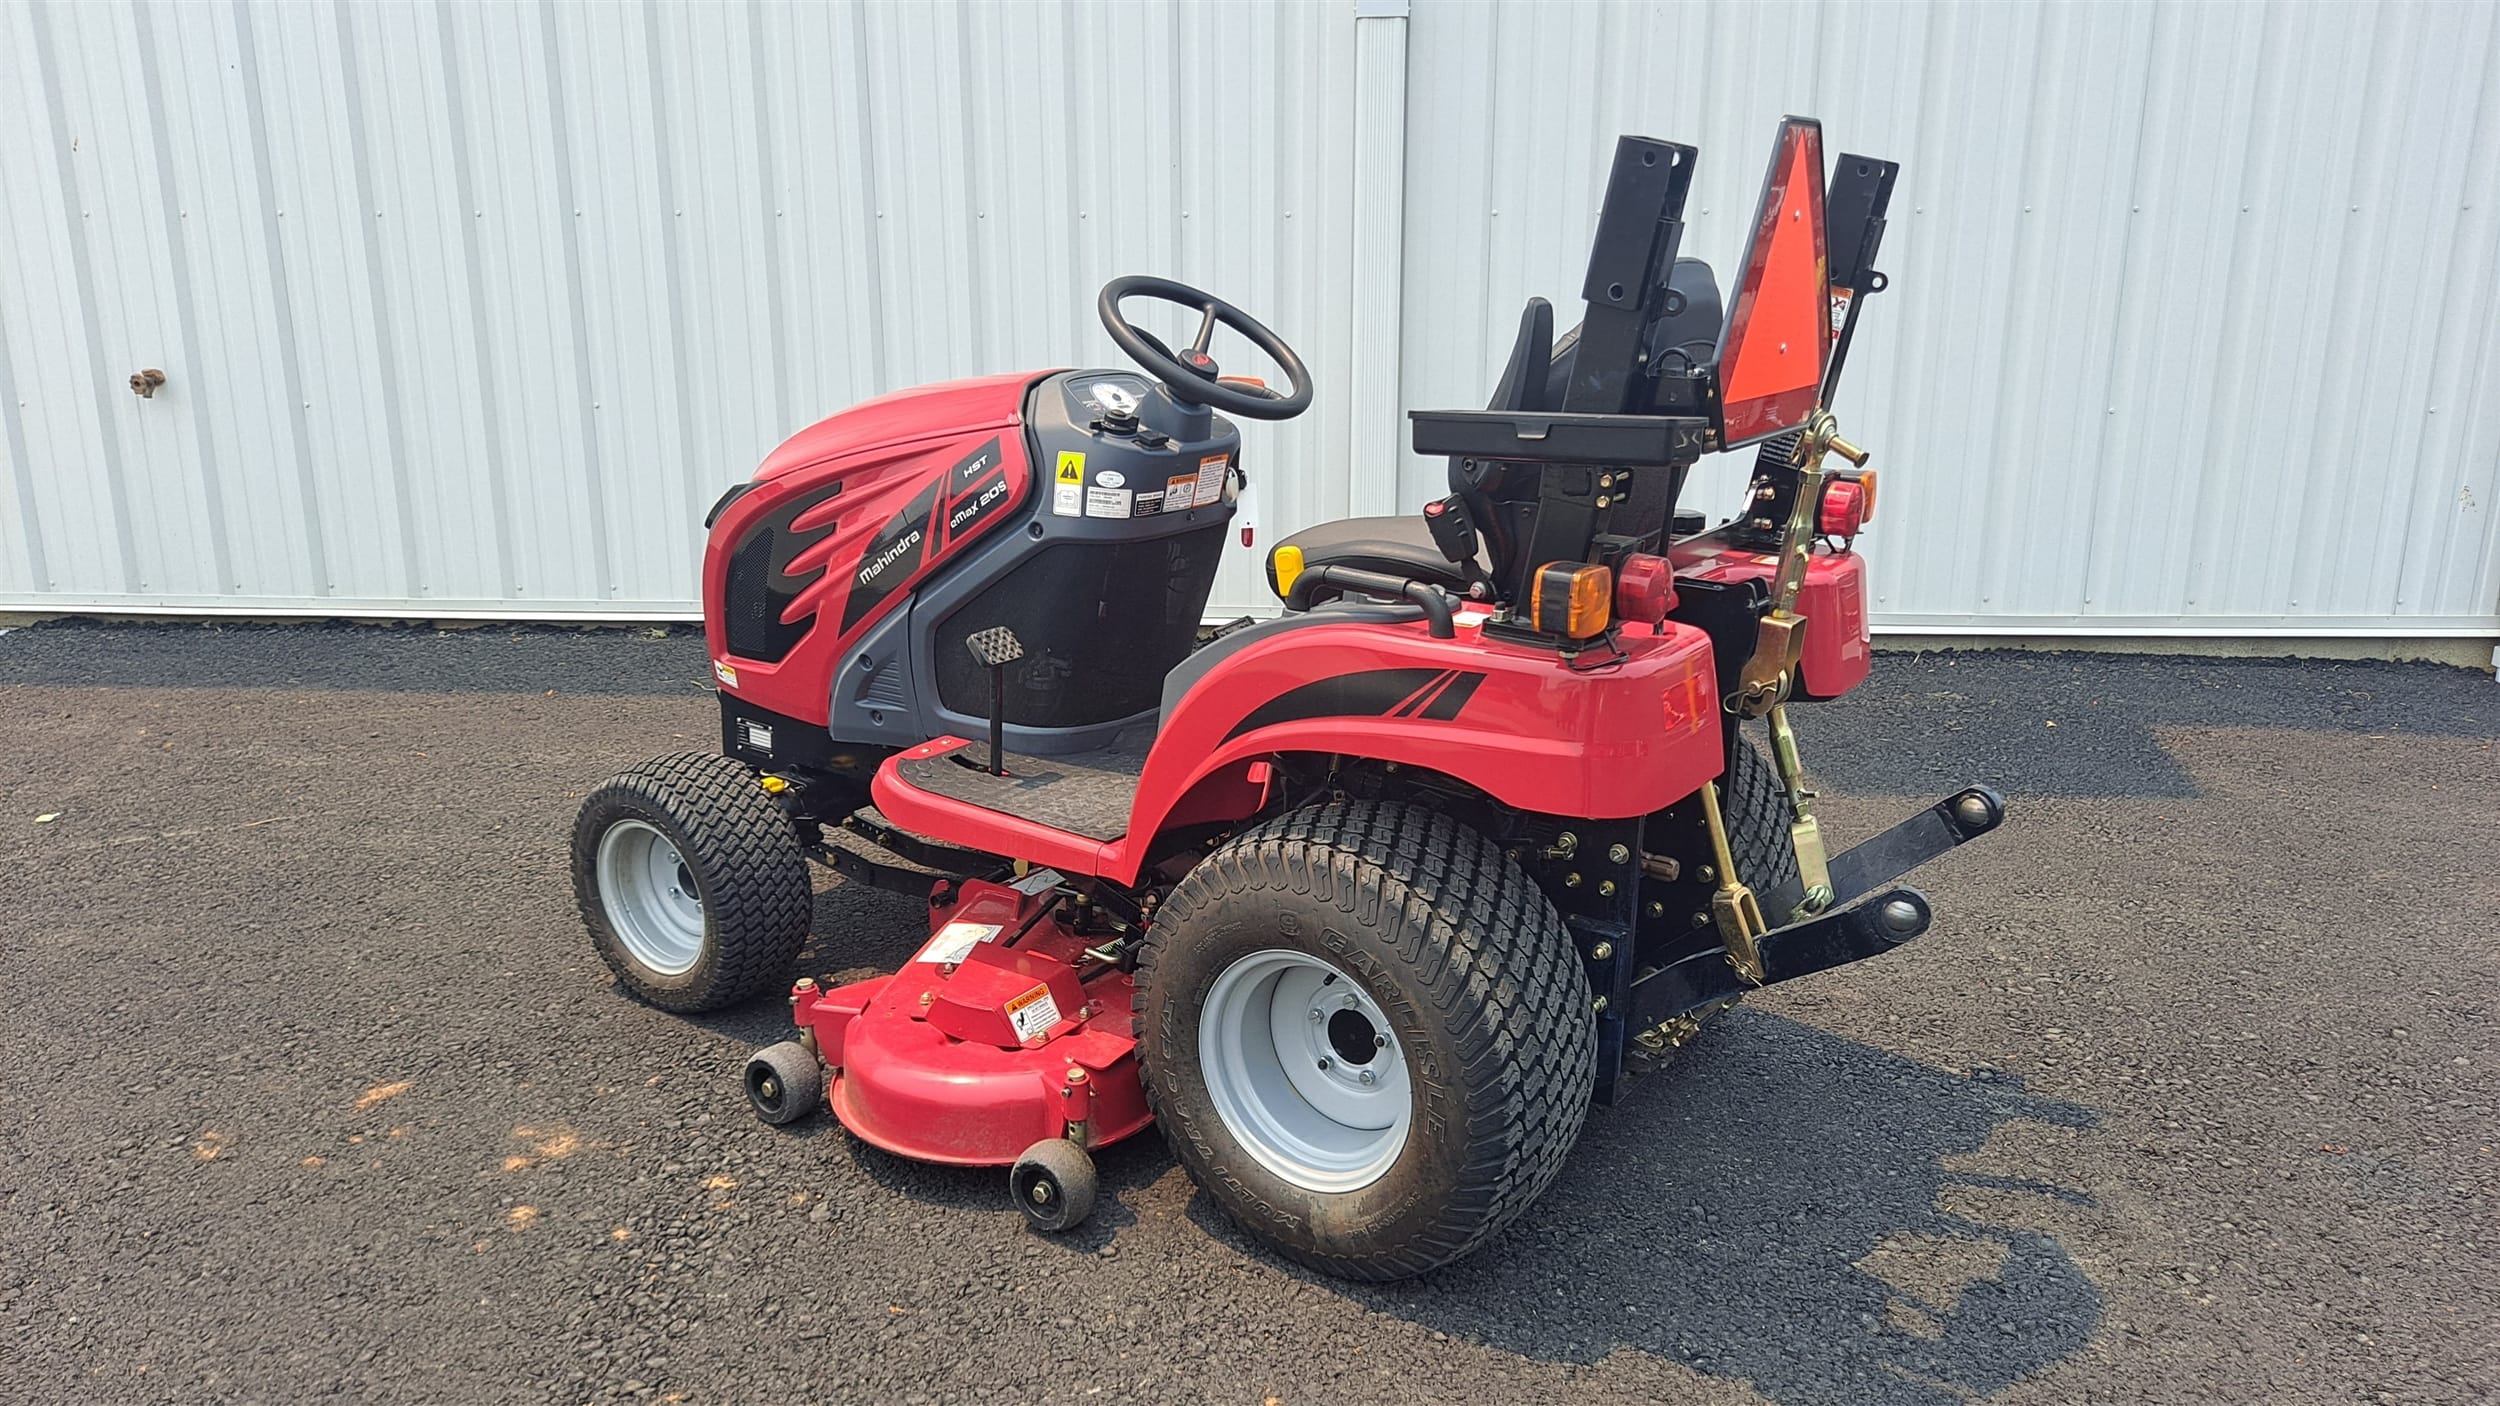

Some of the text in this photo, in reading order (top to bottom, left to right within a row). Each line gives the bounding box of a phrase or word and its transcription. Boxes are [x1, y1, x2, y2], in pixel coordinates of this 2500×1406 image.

[963, 455, 988, 478] HST
[979, 480, 1007, 507] 20S
[858, 530, 921, 585] Mahindra
[1017, 988, 1045, 1007] WARNING
[1319, 926, 1447, 1144] CARLISLE
[1163, 1069, 1214, 1160] TRAC
[1212, 1165, 1302, 1230] MULTI
